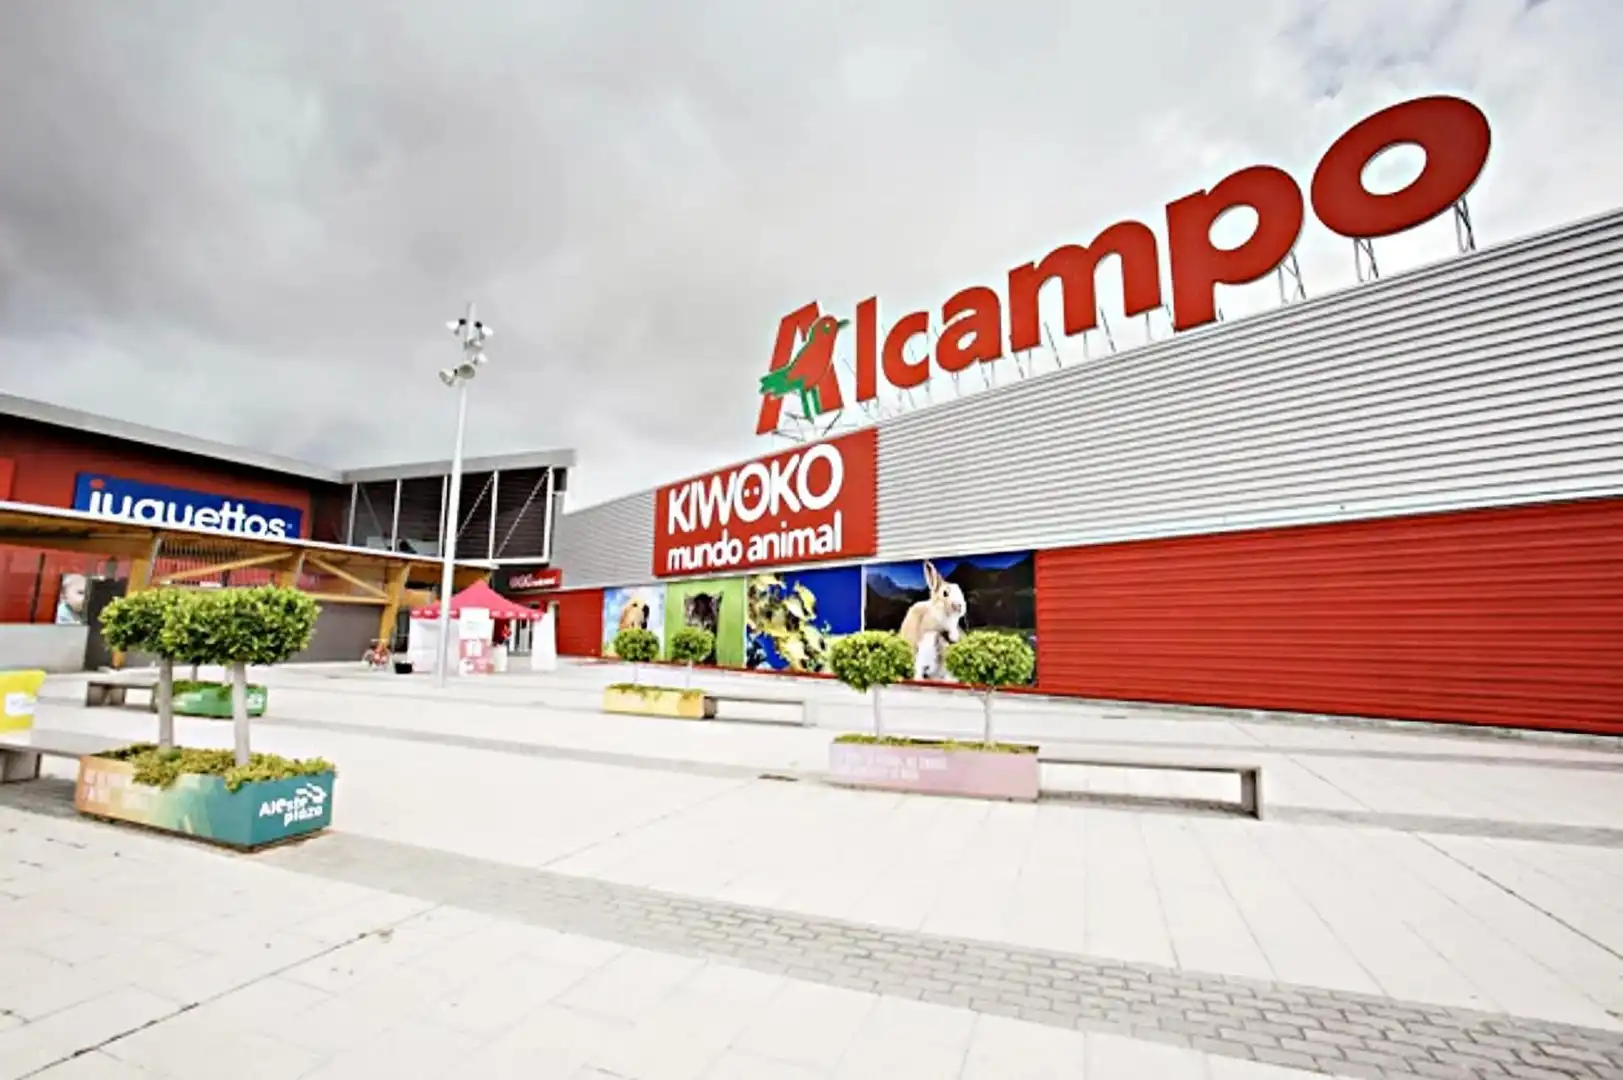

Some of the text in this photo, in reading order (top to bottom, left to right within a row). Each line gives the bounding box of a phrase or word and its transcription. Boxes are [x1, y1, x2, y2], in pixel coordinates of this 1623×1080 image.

[756, 95, 1491, 434] Alcampo
[668, 444, 844, 535] KIWOKO
[667, 509, 842, 572] mundo animal
